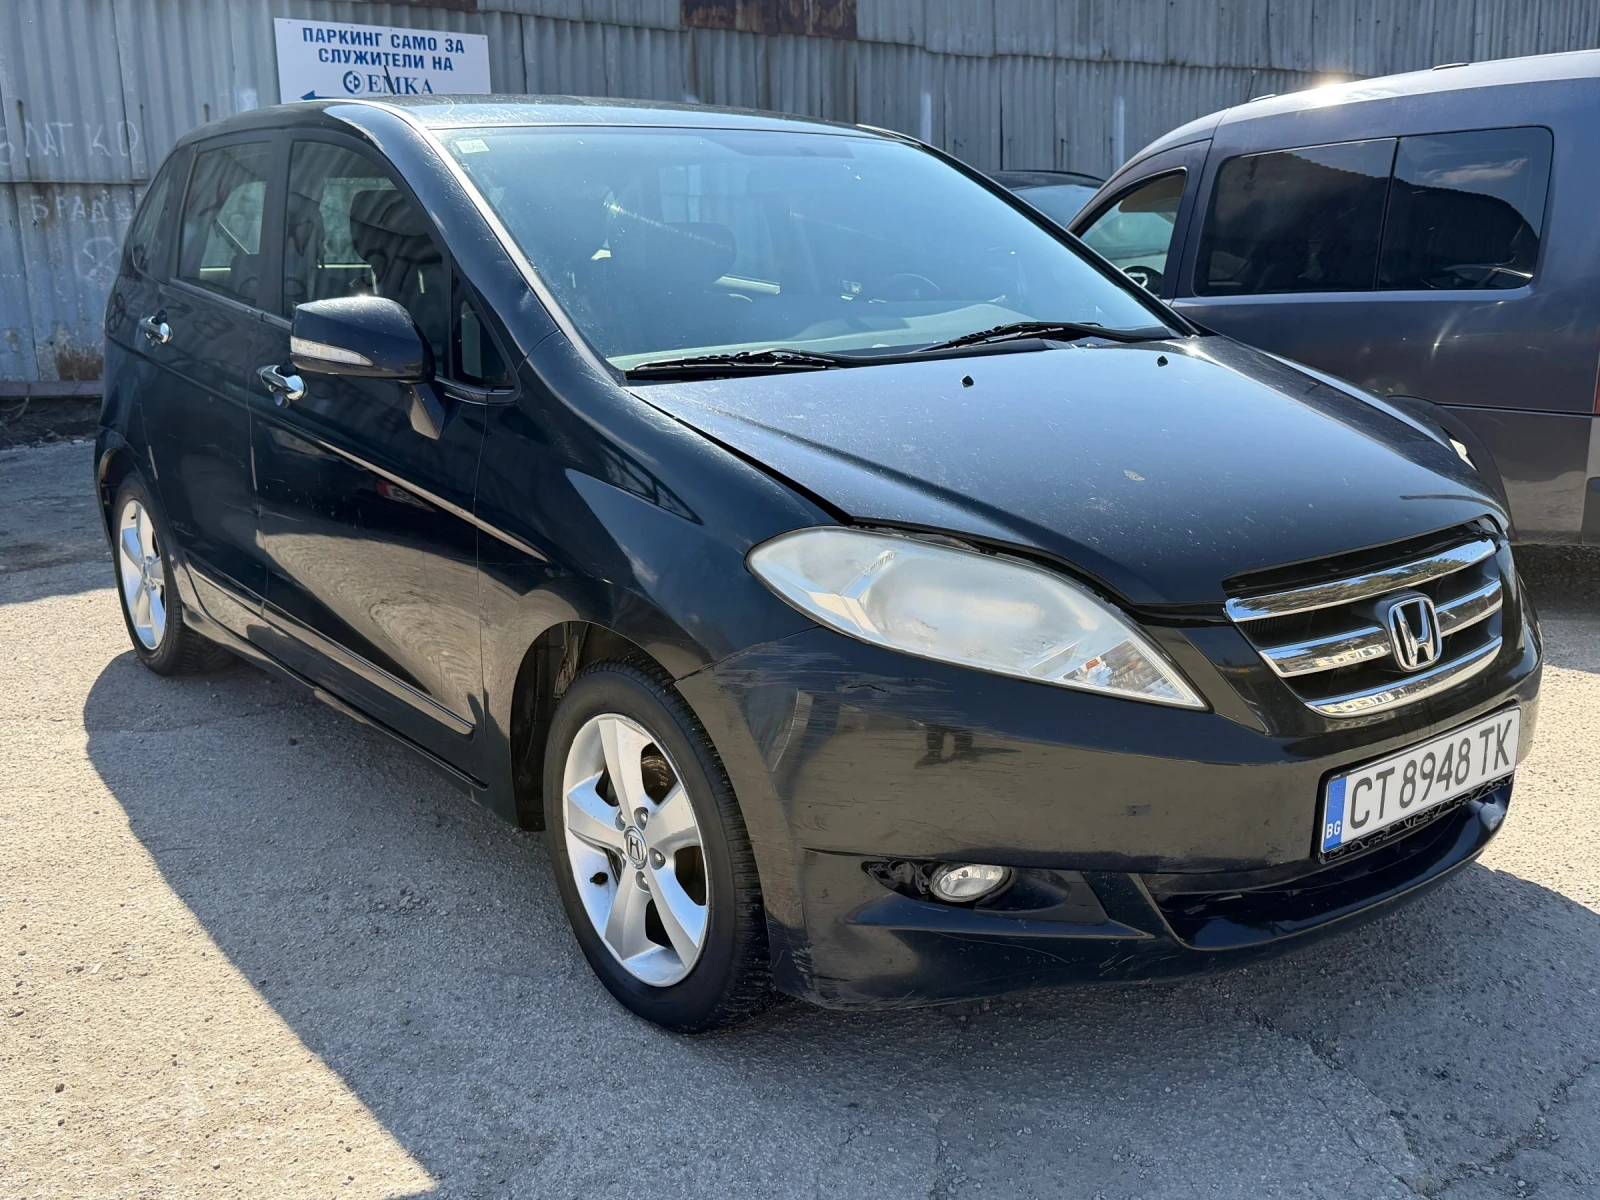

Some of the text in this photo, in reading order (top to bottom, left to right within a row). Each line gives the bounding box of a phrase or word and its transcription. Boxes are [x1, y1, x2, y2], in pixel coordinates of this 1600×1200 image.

[302, 27, 465, 54] ПАРКИНГ САМО ЗА
[318, 48, 454, 71] СЛУЖИТЕЛИ НА
[1325, 820, 1341, 839] BG
